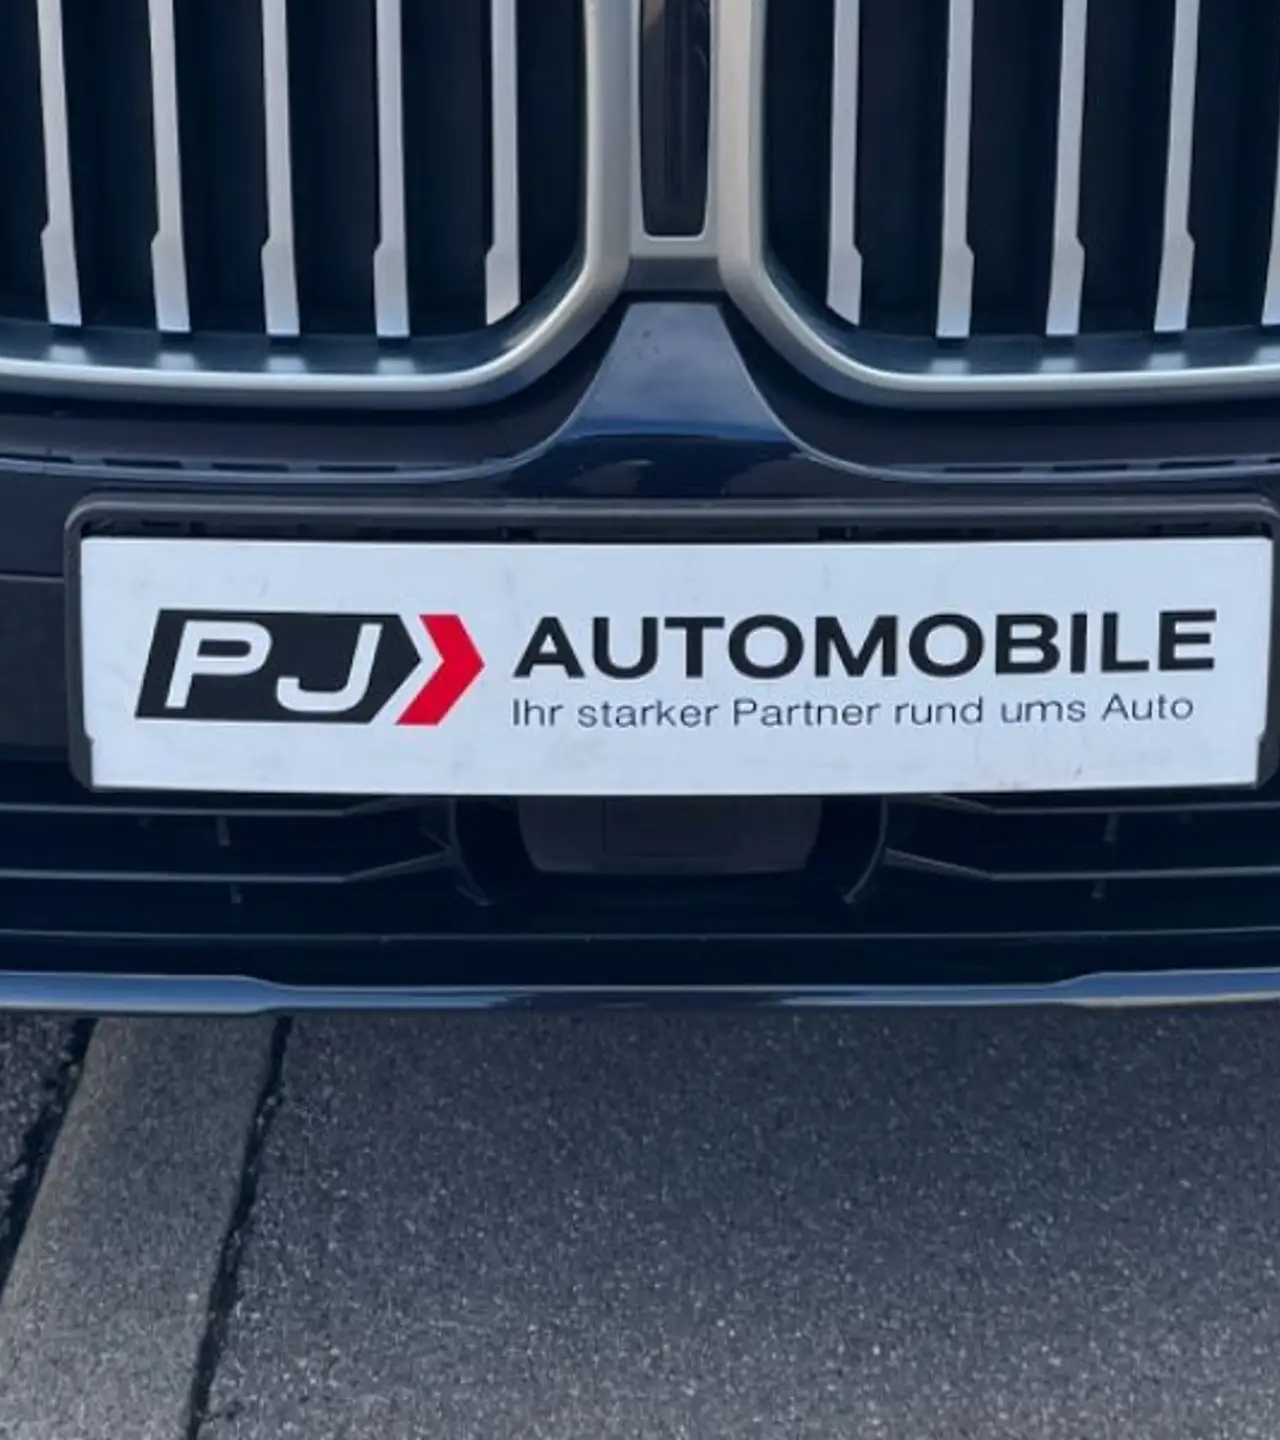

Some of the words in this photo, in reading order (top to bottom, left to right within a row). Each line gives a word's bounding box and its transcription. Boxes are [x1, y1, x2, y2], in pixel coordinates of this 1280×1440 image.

[163, 619, 384, 714] PJ
[512, 609, 1218, 680] AUTOMOBILE
[512, 698, 565, 727] Ihr
[577, 699, 720, 728] starker
[732, 698, 882, 727] Partner
[894, 696, 984, 726] rund
[1000, 700, 1087, 725] ums
[1101, 693, 1195, 722] Auto
